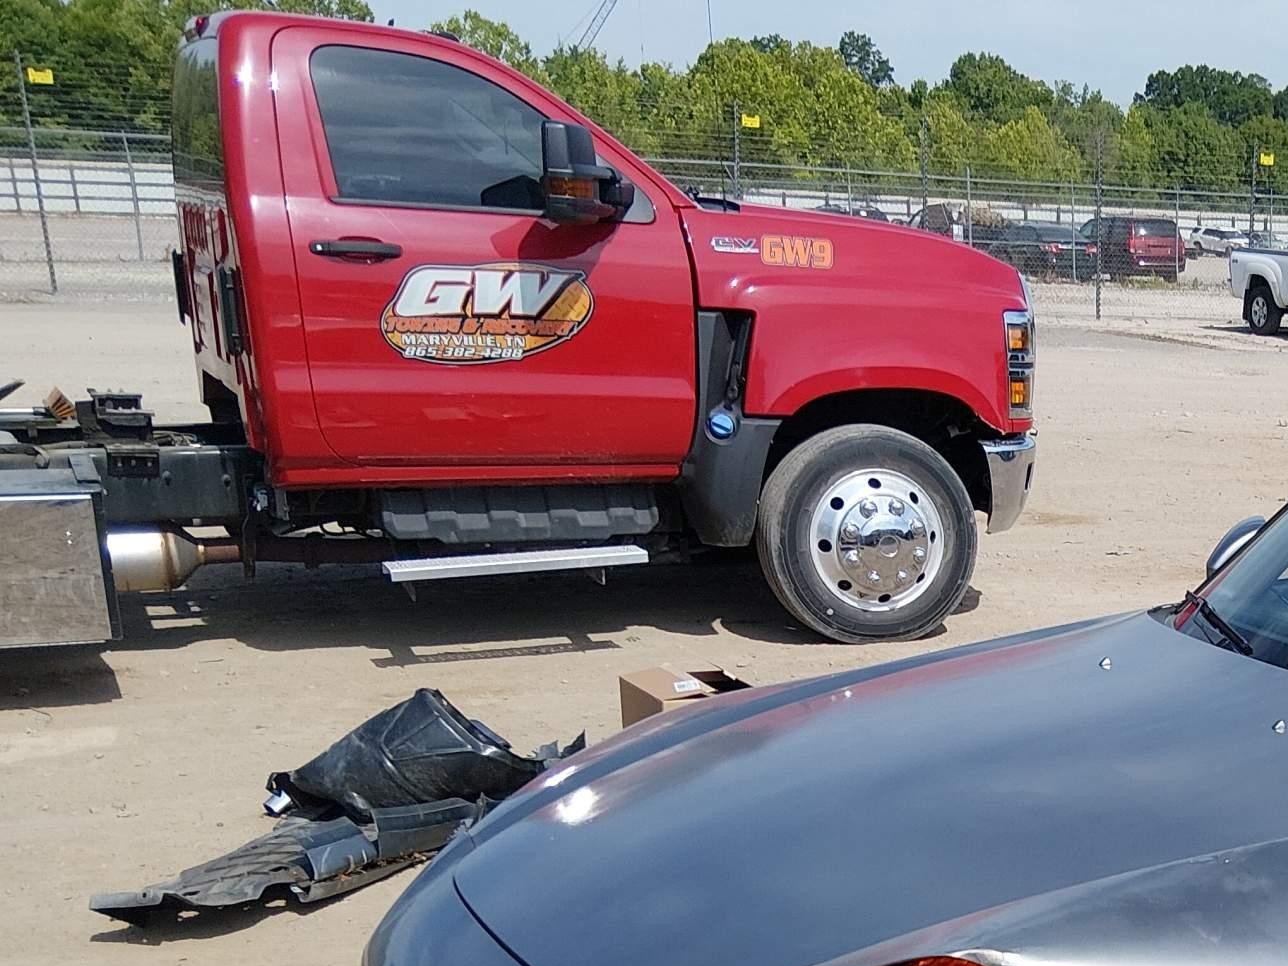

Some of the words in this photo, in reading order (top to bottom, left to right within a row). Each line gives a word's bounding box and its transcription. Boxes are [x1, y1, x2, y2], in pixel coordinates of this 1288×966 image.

[761, 234, 833, 269] GW9
[394, 267, 578, 318] GW
[400, 333, 501, 348] MARYVILLE,
[504, 335, 527, 348] TN
